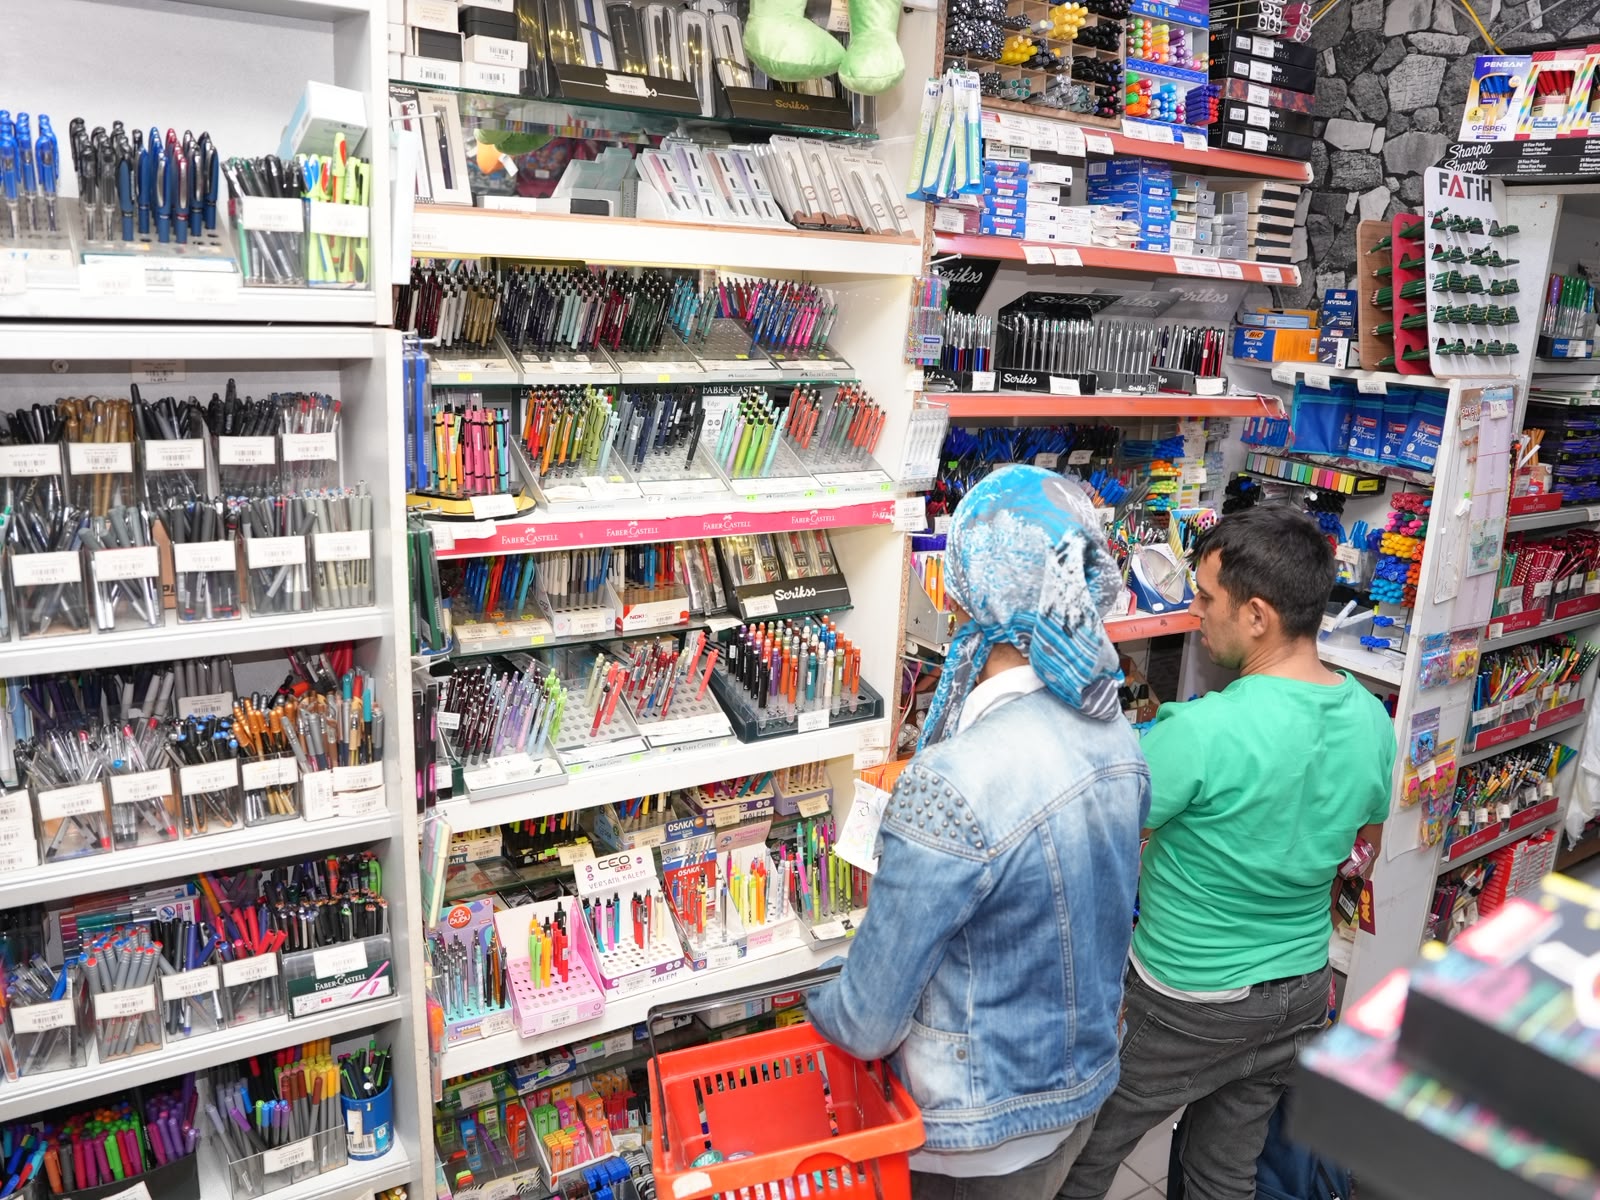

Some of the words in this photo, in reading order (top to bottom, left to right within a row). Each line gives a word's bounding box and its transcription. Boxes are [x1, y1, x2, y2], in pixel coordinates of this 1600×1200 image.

[775, 99, 809, 110] Scrikss
[1449, 142, 1493, 160] Sharpie
[1444, 158, 1488, 173] Sharpie
[1003, 373, 1037, 385] Scrikss
[702, 385, 767, 395] FABER-CASTLL
[501, 534, 559, 545] FABER-CASTELL
[606, 526, 660, 537] FABER-CASTELL
[703, 519, 751, 531] FABER-CASTELL
[791, 514, 836, 525] FABER-CASTELL
[775, 586, 817, 601] Scrikss
[668, 819, 694, 832] OSAKA
[598, 854, 631, 870] CEO
[622, 869, 647, 881] KALEM
[677, 865, 700, 877] OSAKA
[314, 973, 367, 991] FABER-CASTELL
